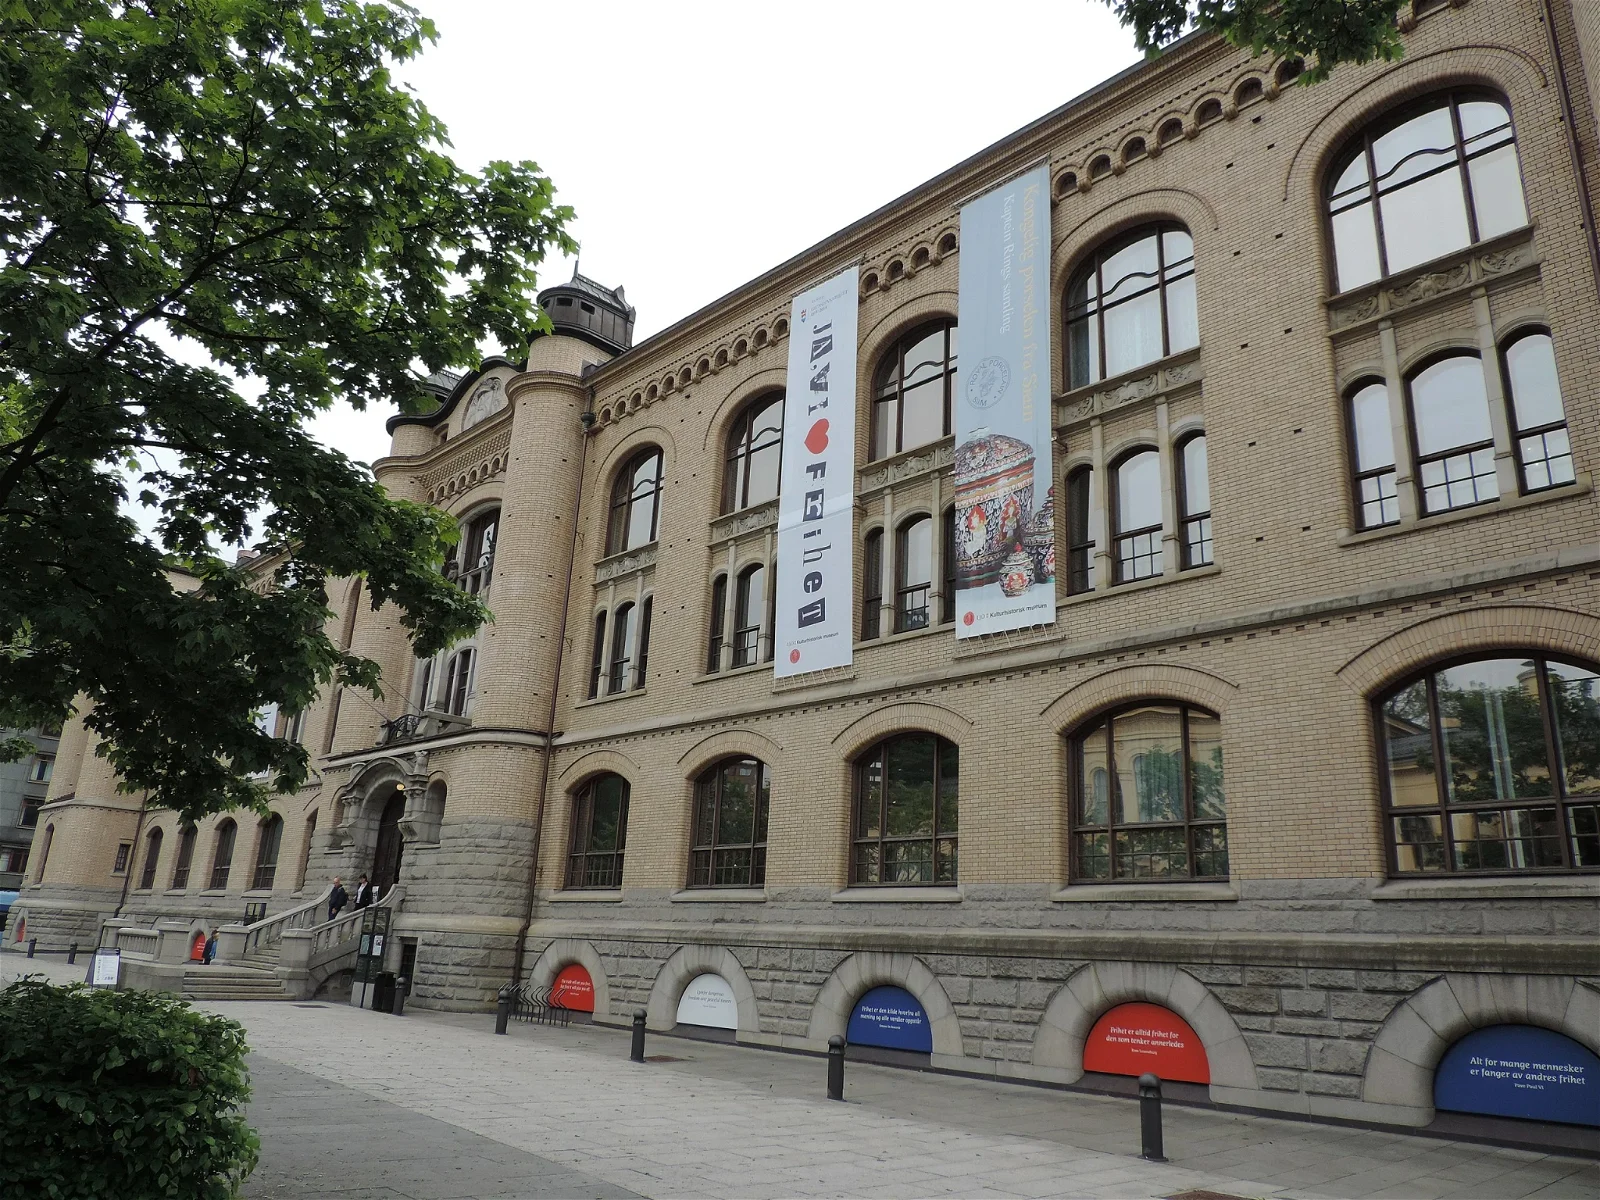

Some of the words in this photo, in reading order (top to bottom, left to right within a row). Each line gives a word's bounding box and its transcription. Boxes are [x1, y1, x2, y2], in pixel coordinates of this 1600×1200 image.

[1001, 193, 1015, 242] Kaptein
[1019, 184, 1039, 262] Kongelig
[1000, 243, 1015, 282] Rings
[999, 283, 1014, 335] samling
[1019, 265, 1038, 340] porselen
[1022, 342, 1037, 369] fra
[1151, 1039, 1184, 1048] annerledes
[1152, 1030, 1168, 1038] frihet
[1470, 1057, 1483, 1065] Alt
[1485, 1058, 1498, 1066] for
[1500, 1060, 1530, 1069] mange
[1533, 1063, 1584, 1073] mennesker
[1482, 1069, 1510, 1079] fanger
[1525, 1073, 1557, 1082] andres
[1558, 1074, 1586, 1085] frihet
